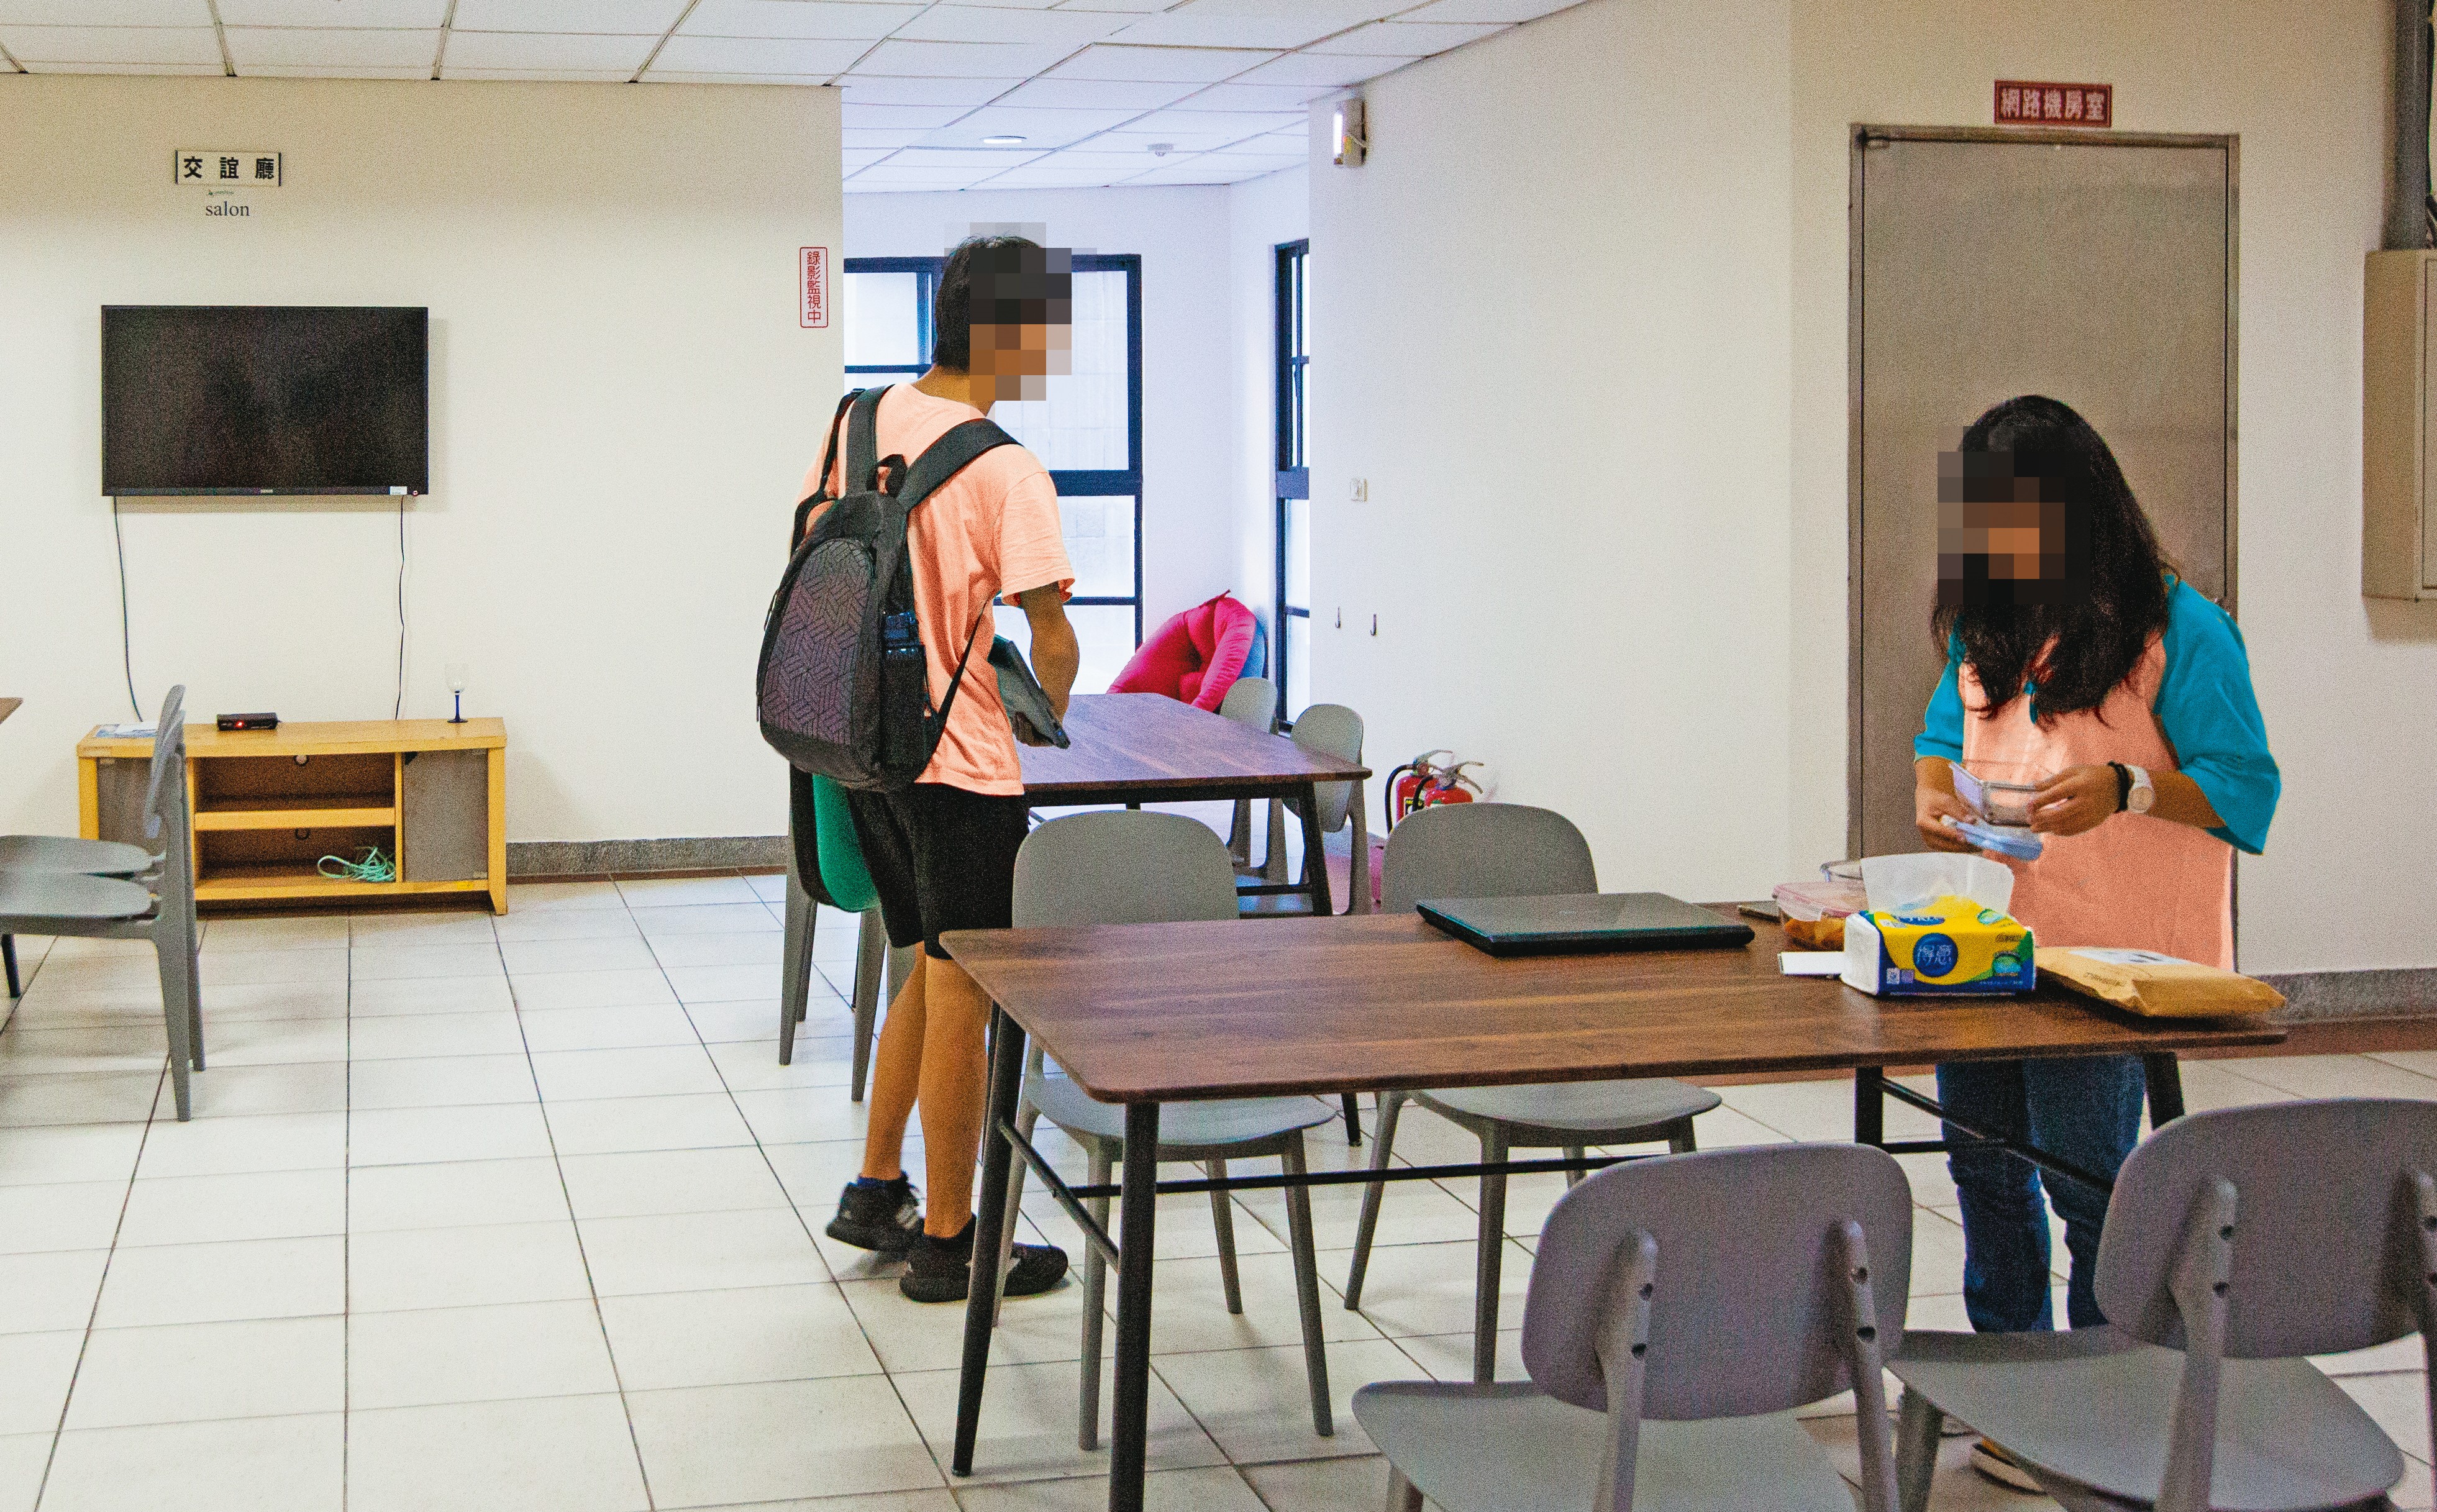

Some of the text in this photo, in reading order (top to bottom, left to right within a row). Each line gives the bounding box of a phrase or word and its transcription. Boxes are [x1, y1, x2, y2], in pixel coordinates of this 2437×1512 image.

[2002, 88, 2105, 121] 網路機房室
[184, 156, 274, 179] 交誼廳
[206, 201, 250, 216] salon
[807, 251, 821, 323] 錄影監視中
